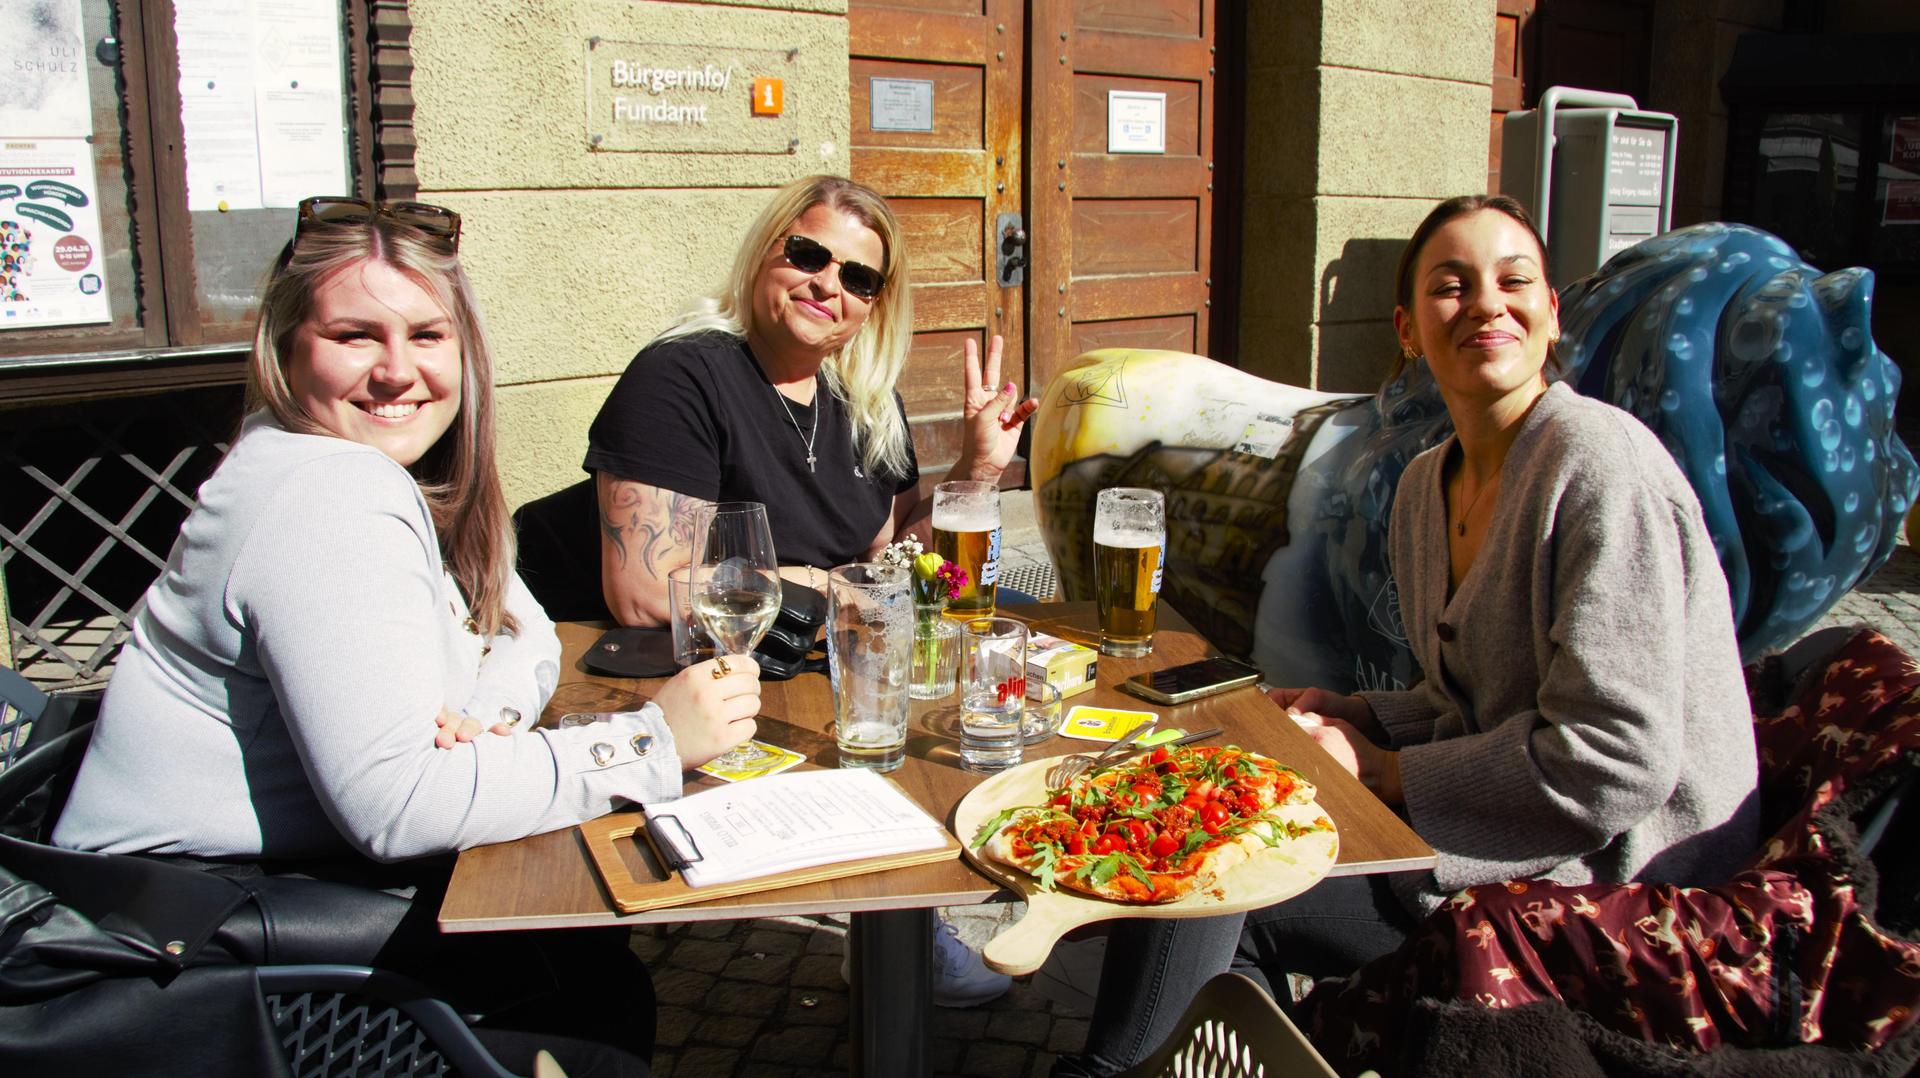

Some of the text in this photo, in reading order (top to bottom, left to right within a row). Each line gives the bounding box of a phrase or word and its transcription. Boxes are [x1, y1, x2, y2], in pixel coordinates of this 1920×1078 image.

[50, 47, 76, 57] ULI
[14, 60, 77, 73] SCHULZ
[613, 59, 732, 92] Bürgerinfo/
[614, 96, 708, 123] Fundamt
